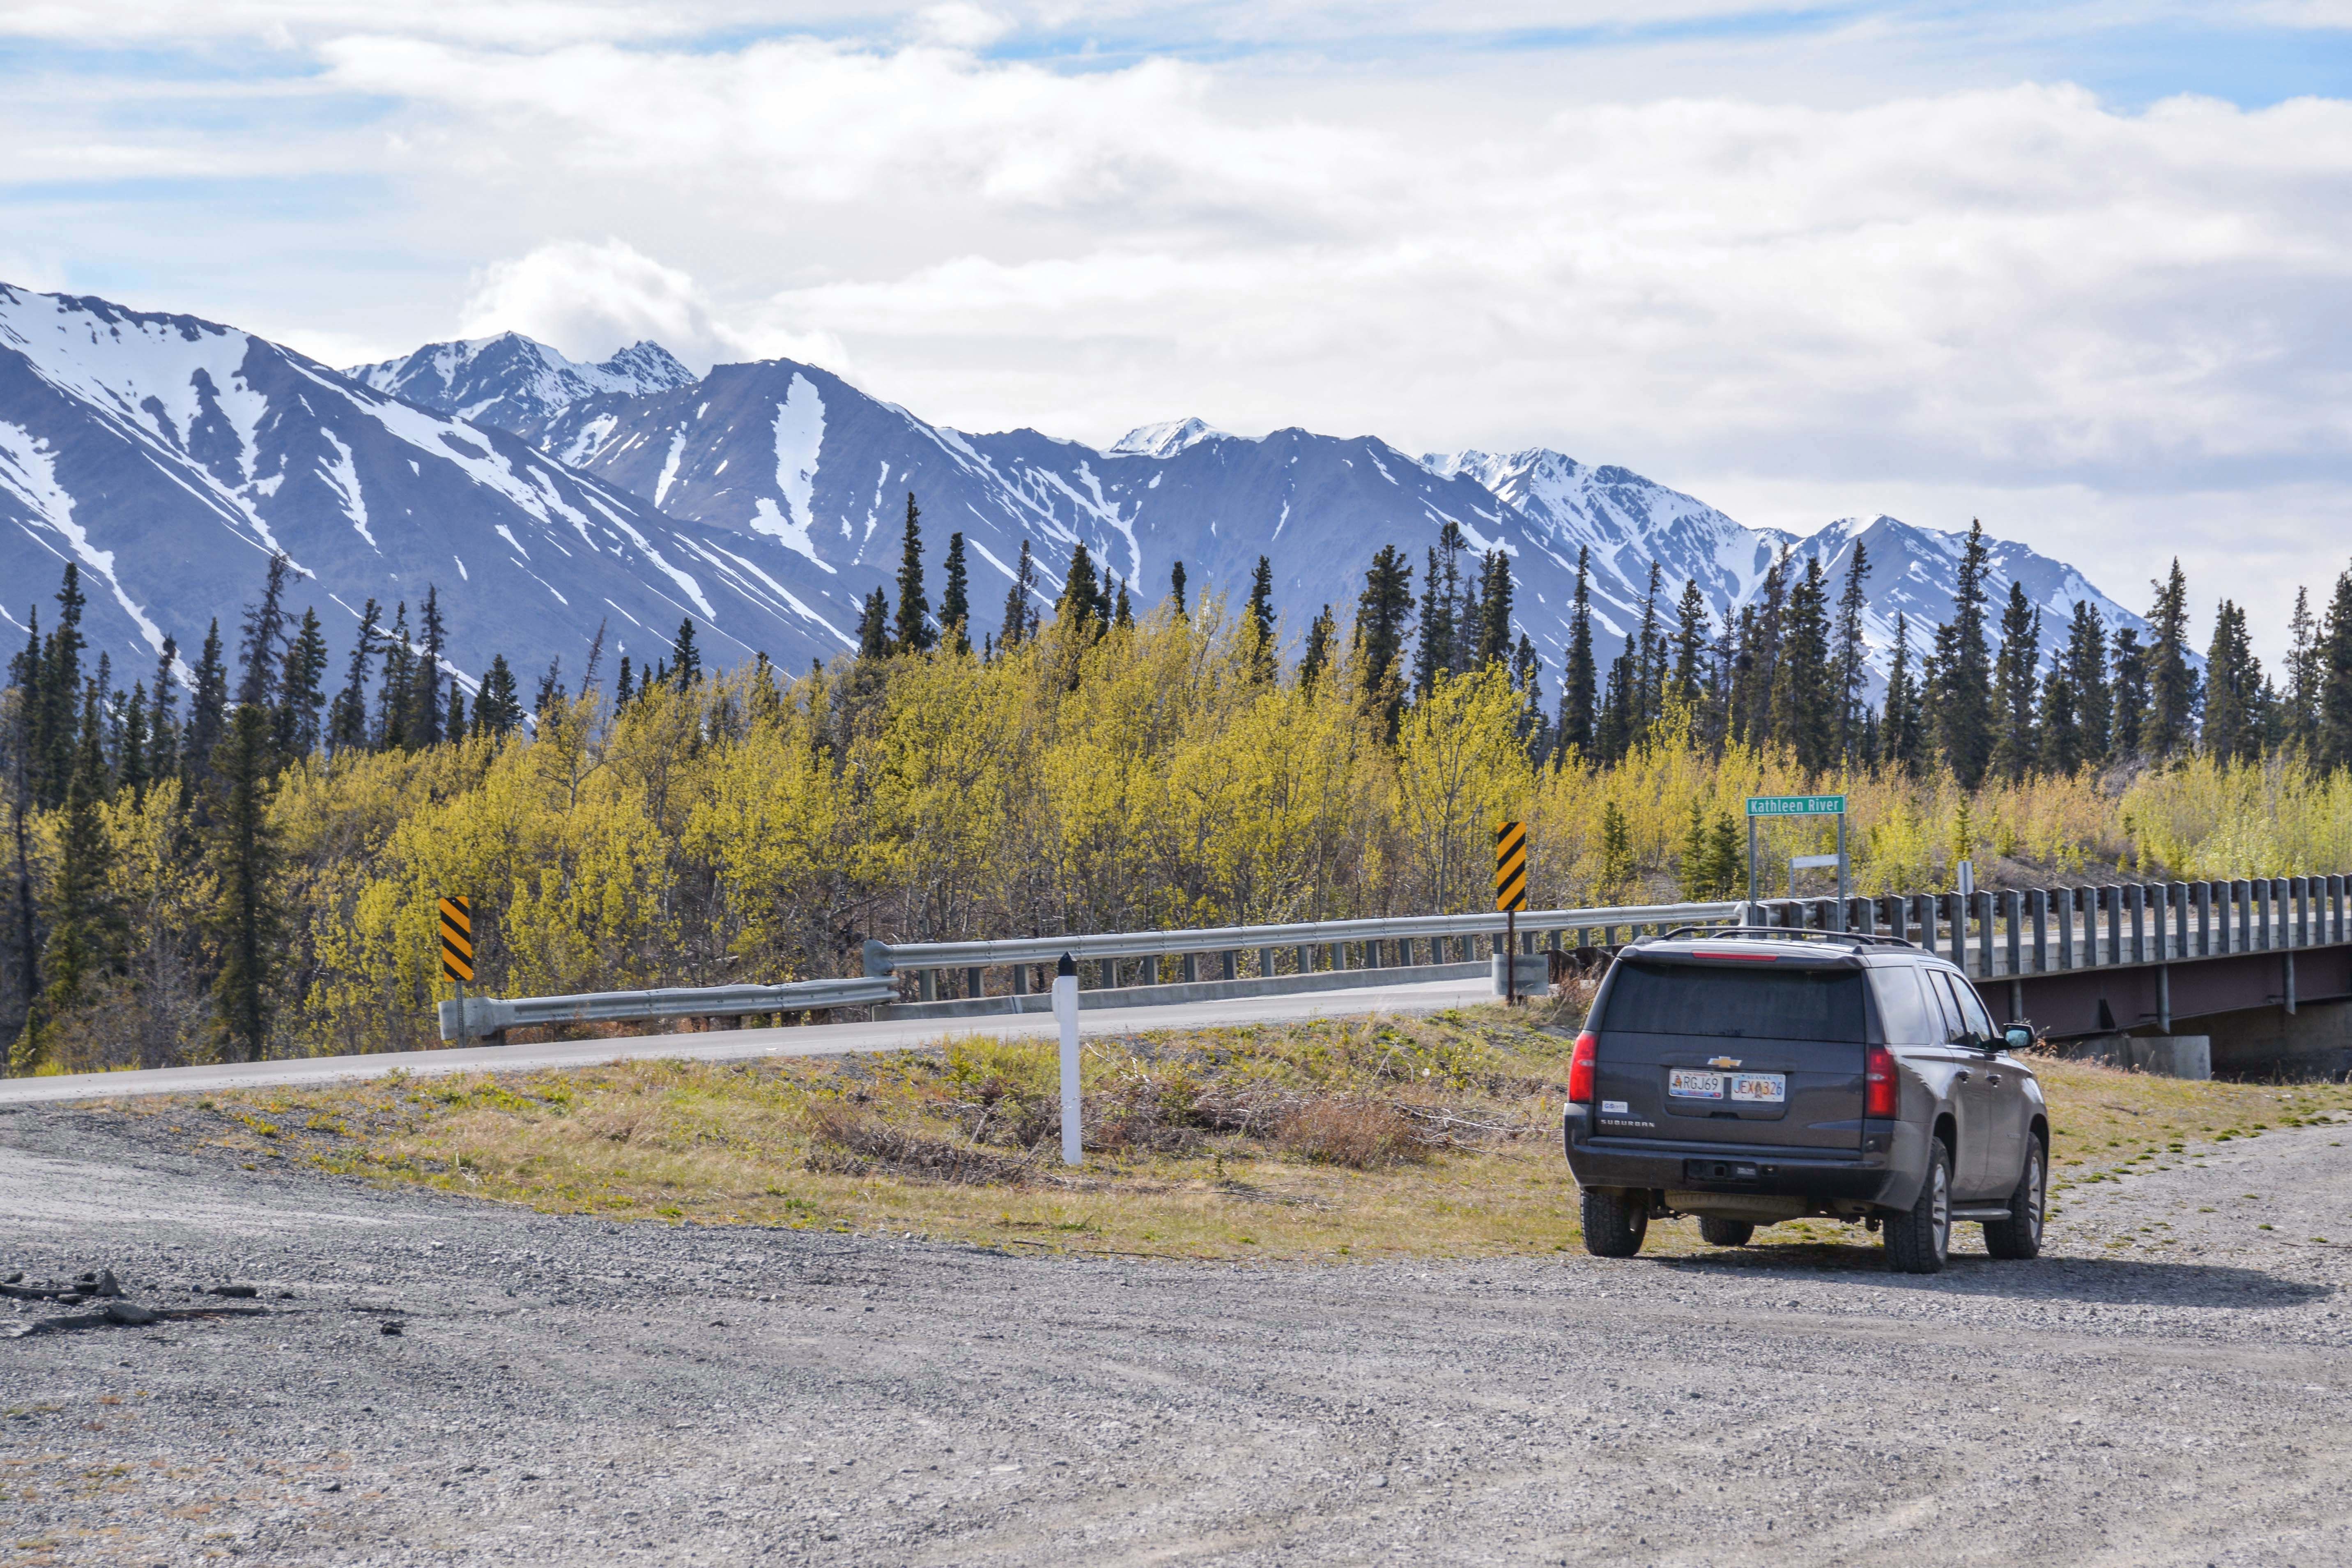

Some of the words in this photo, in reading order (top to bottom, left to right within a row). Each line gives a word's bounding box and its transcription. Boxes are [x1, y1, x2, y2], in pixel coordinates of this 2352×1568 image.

[1751, 799, 1803, 812] Kathleen
[1808, 799, 1838, 811] River
[1684, 1076, 1718, 1090] RGJ69
